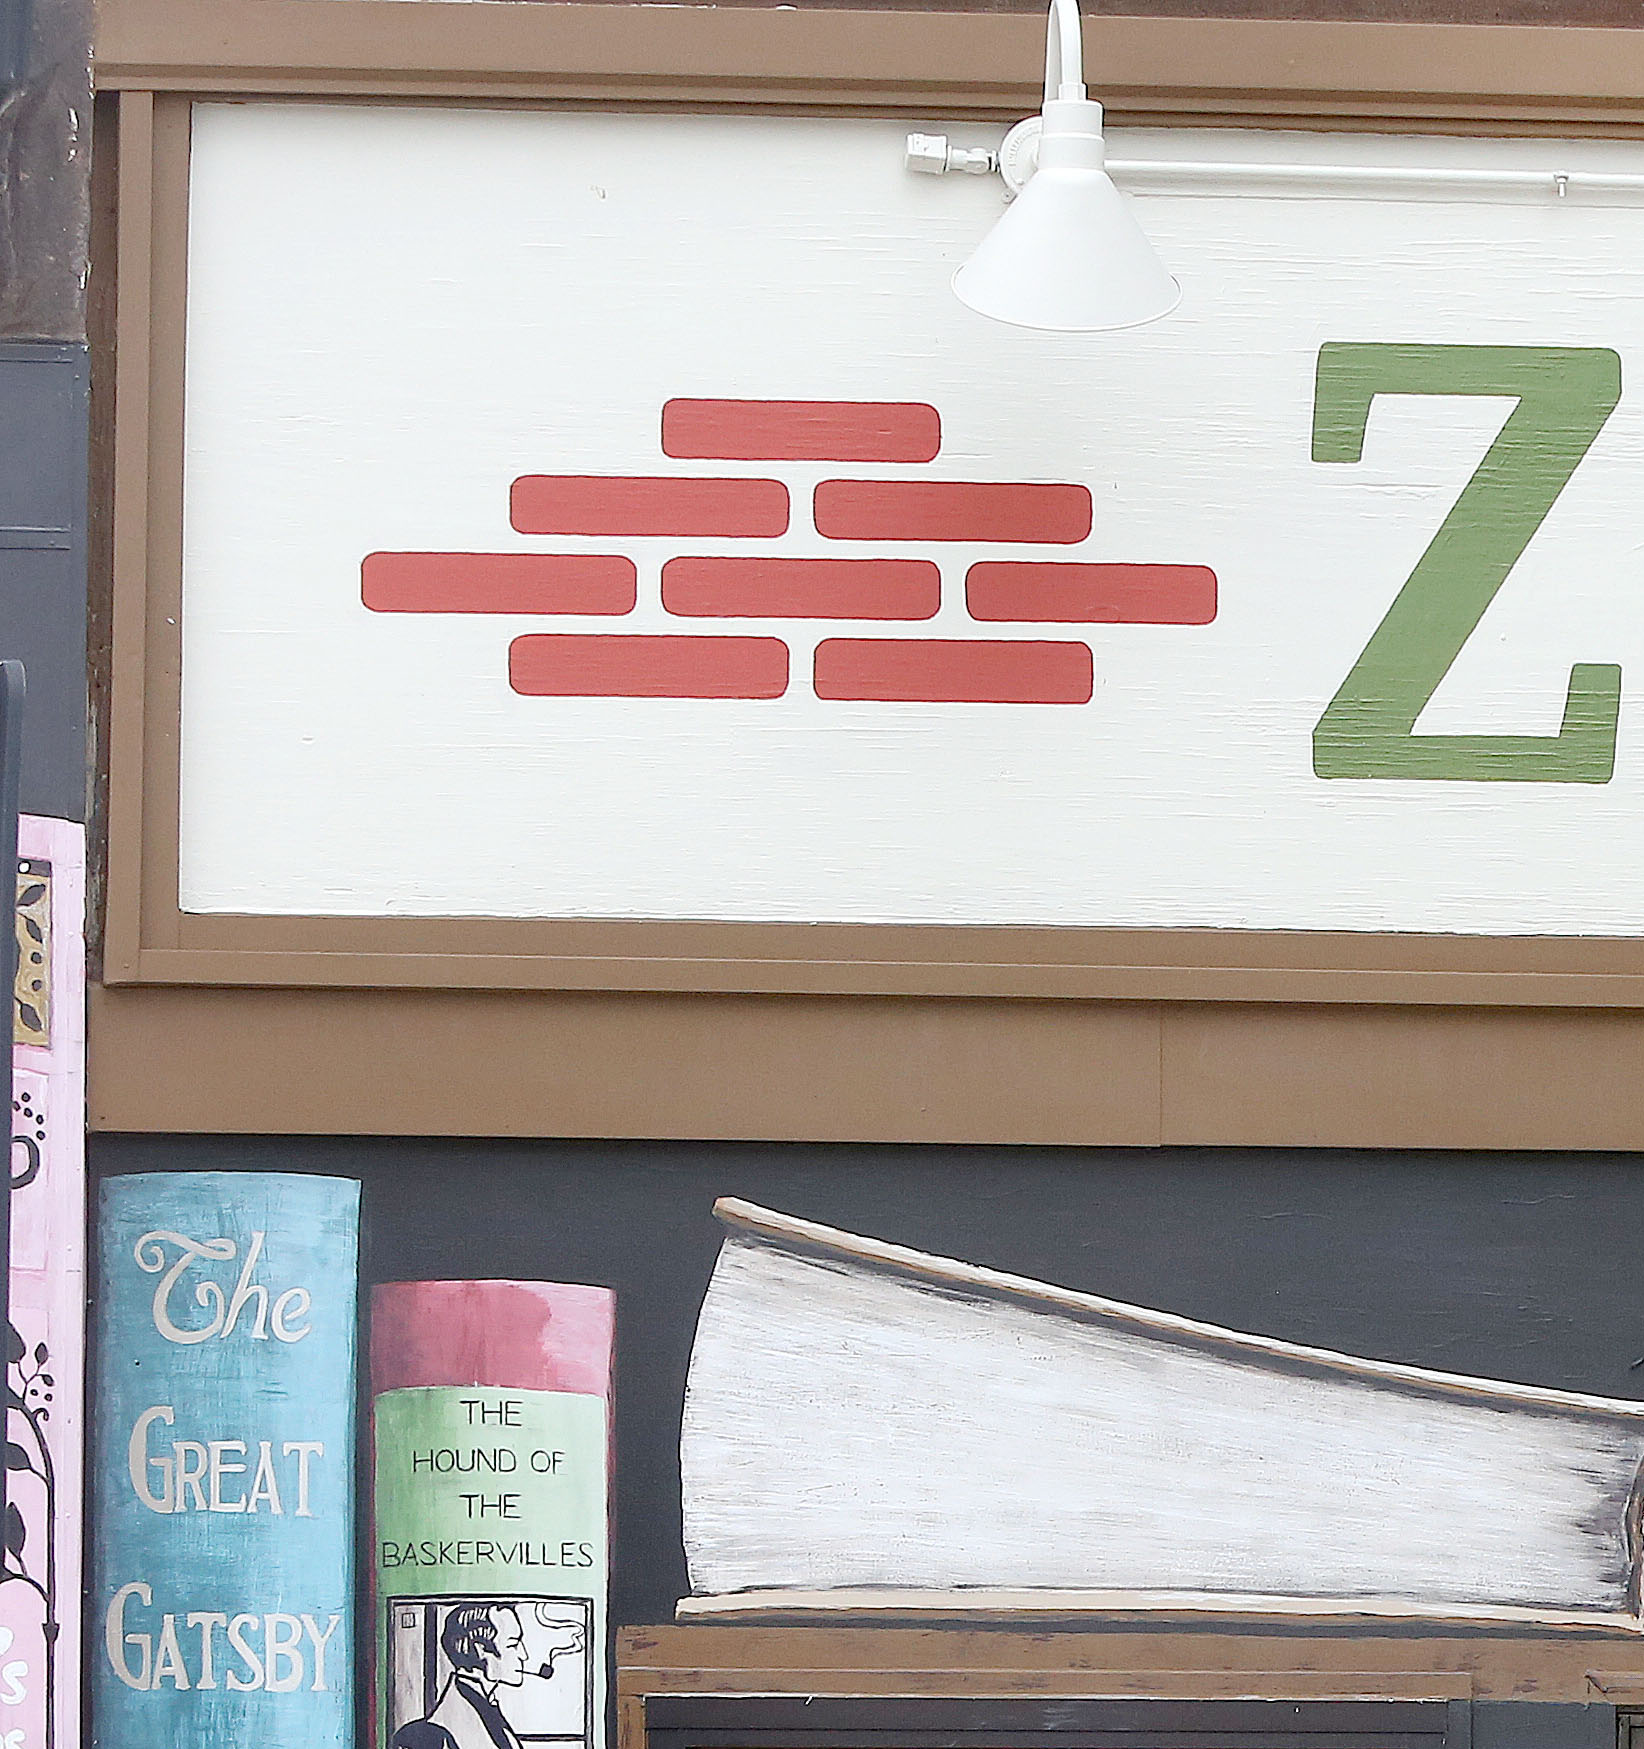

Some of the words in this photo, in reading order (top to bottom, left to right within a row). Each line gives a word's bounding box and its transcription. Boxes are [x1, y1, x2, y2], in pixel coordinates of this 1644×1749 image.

[133, 1231, 311, 1343] The
[458, 1400, 523, 1428] THE
[129, 1406, 323, 1517] GREAT
[412, 1448, 516, 1475] HOUND
[530, 1449, 566, 1476] OF
[458, 1494, 522, 1520] THE
[381, 1541, 594, 1568] BASKERVILLES
[106, 1582, 342, 1692] GATSBY
